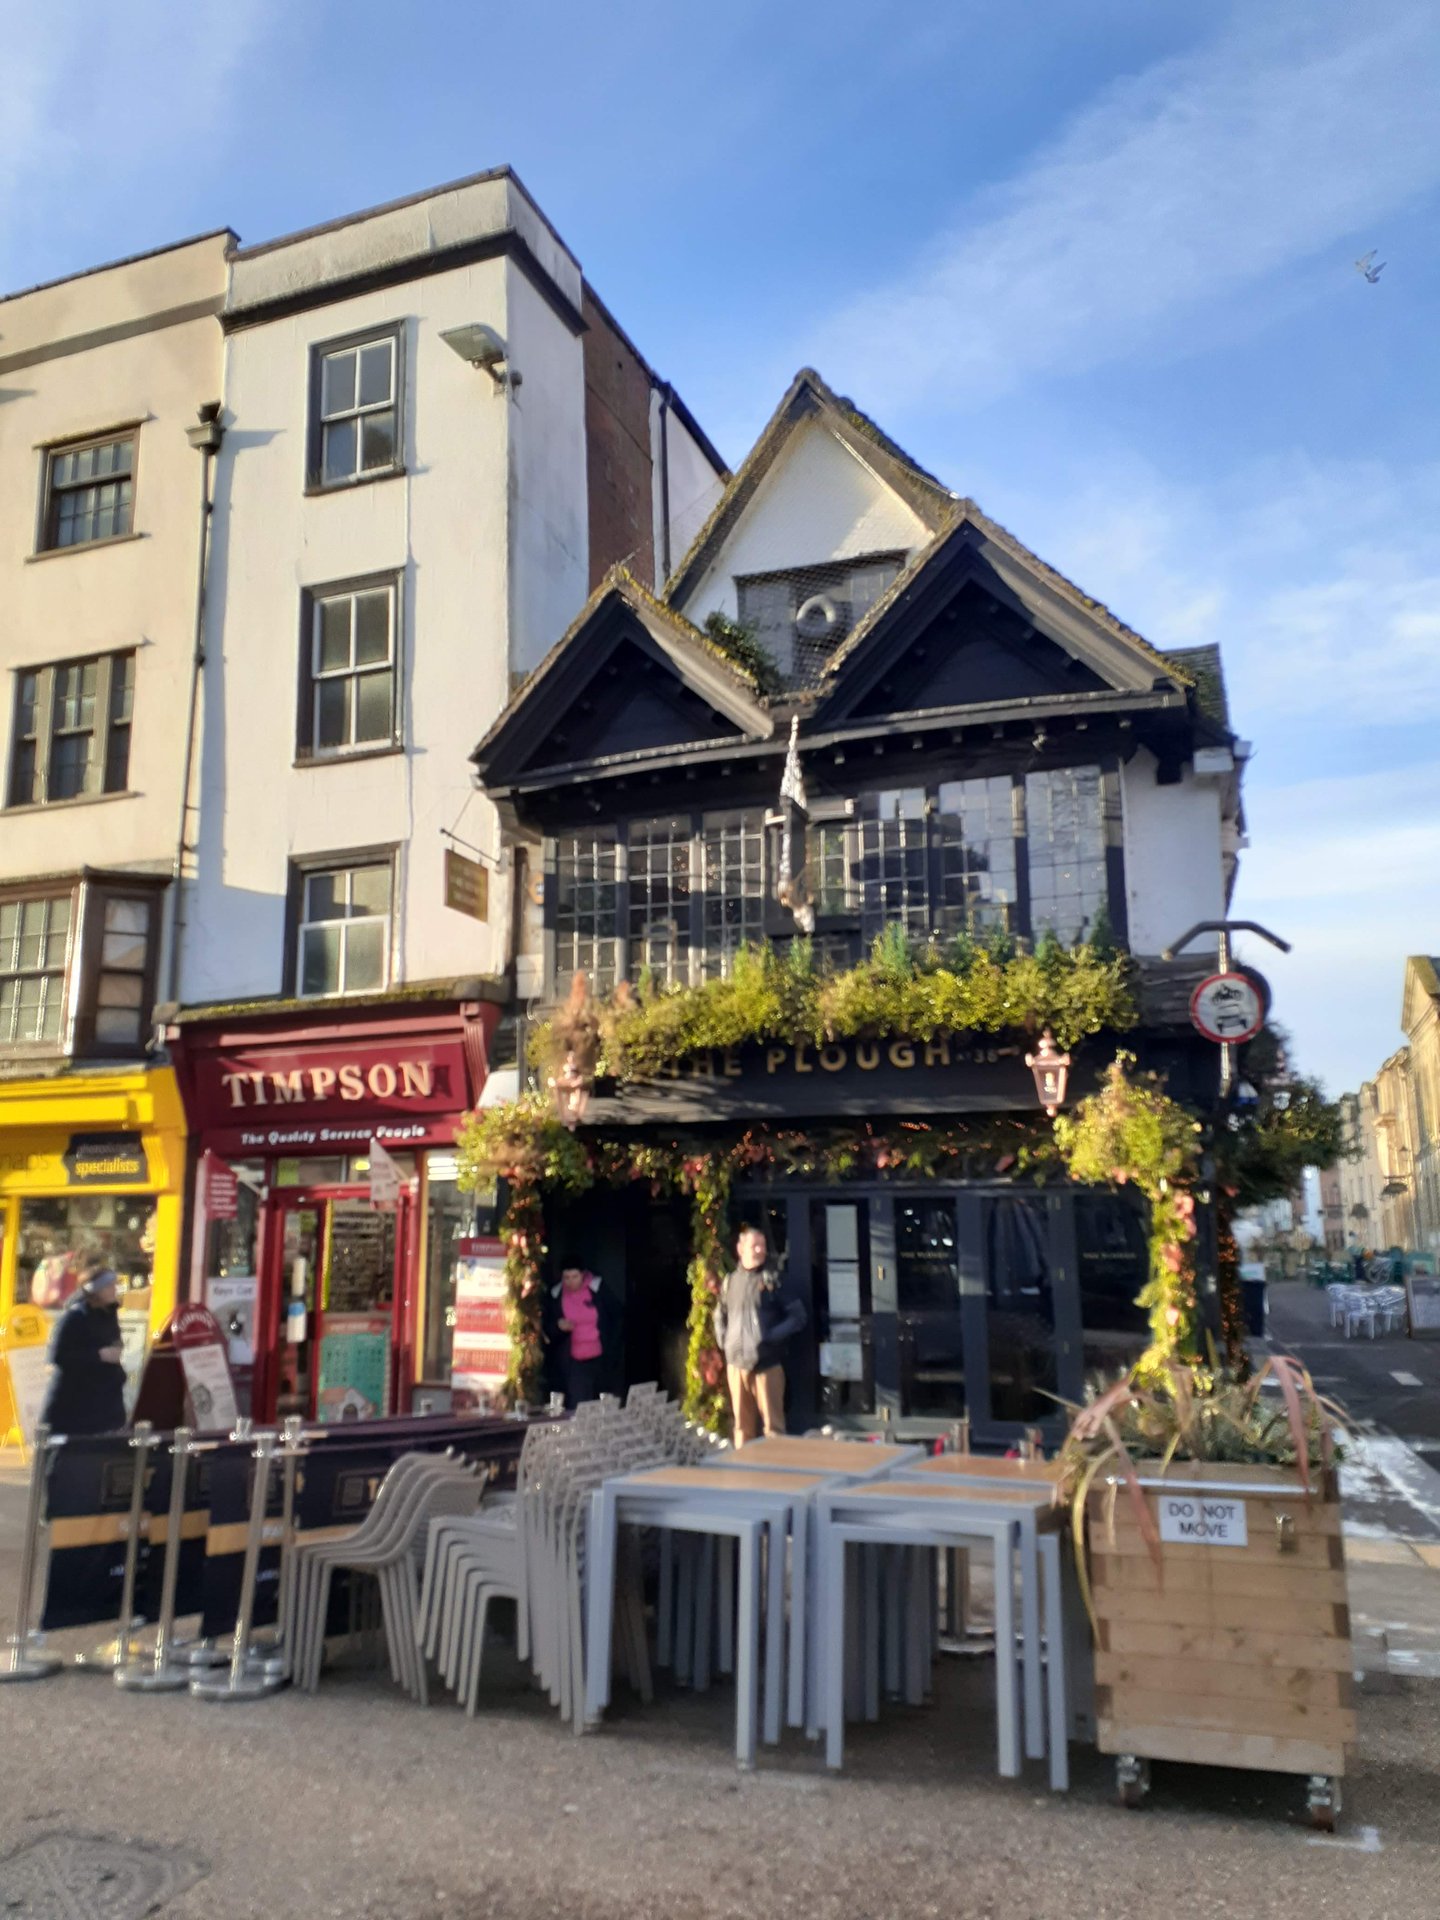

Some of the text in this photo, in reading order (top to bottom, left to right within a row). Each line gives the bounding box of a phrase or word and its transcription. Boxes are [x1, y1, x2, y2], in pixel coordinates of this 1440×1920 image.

[766, 1041, 951, 1073] PLOUGH
[222, 1060, 433, 1107] TIMPSON
[241, 1124, 426, 1145] The Quality Service People
[75, 1157, 140, 1179] specialists
[1168, 1502, 1235, 1520] DO NOT
[1179, 1521, 1228, 1538] MOVE
